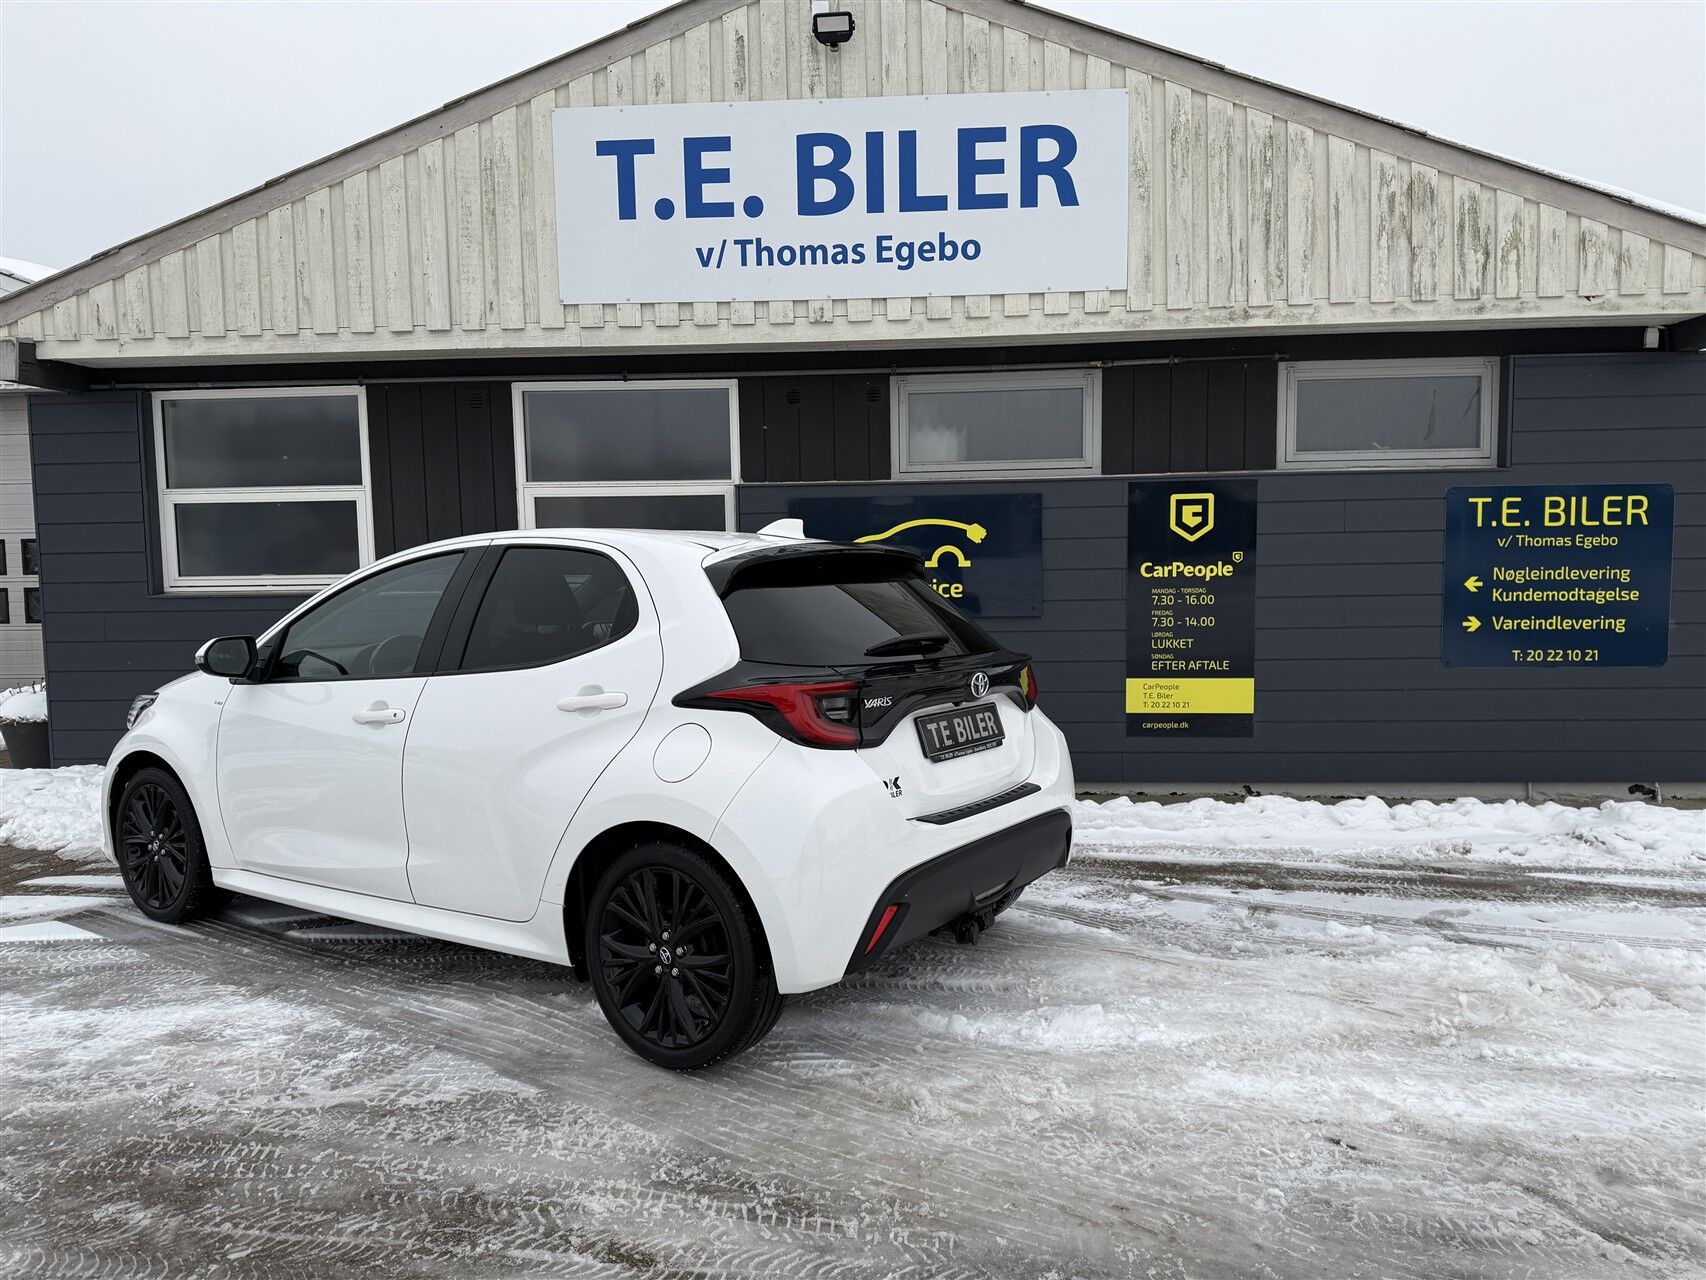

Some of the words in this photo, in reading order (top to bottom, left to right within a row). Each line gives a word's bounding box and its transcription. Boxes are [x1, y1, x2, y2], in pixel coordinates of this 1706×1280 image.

[595, 136, 764, 221] T.E.
[796, 124, 1080, 217] BILER
[695, 242, 727, 269] v/
[734, 238, 865, 267] Thomas
[876, 232, 982, 270] Egebo
[1468, 496, 1530, 527] T.E.
[1543, 495, 1649, 527] BILER
[1497, 535, 1513, 548] v/
[1516, 534, 1572, 547] Thomas
[1575, 534, 1618, 549] Egebo
[1140, 561, 1234, 581] CarPeople
[1493, 566, 1631, 583] Nøgleindlevering
[1151, 595, 1175, 605] 7.30
[1185, 594, 1215, 605] 16.00
[1492, 587, 1640, 604] Kundemodtagelse
[1151, 617, 1174, 627] 7.30
[1184, 616, 1215, 627] 14.00
[1492, 615, 1626, 633] Vareindlevering
[1151, 638, 1194, 649] LUKKET
[1512, 650, 1523, 661] T:
[1526, 650, 1543, 661] 20
[1547, 650, 1563, 661] 22
[1566, 650, 1581, 661] 10
[1585, 650, 1599, 661] 21
[1151, 660, 1186, 671] EFTER
[1188, 660, 1230, 671] AFTALE
[1142, 683, 1180, 691] CarPeople
[1143, 692, 1156, 700] T.E.
[1156, 692, 1174, 700] Biler
[1143, 701, 1150, 709] T:
[1150, 701, 1160, 709] 20
[1161, 701, 1171, 709] 22
[1172, 701, 1181, 709] 10
[1181, 701, 1190, 709] 21
[953, 711, 999, 743] BILER
[1142, 722, 1189, 730] carpeople.dk
